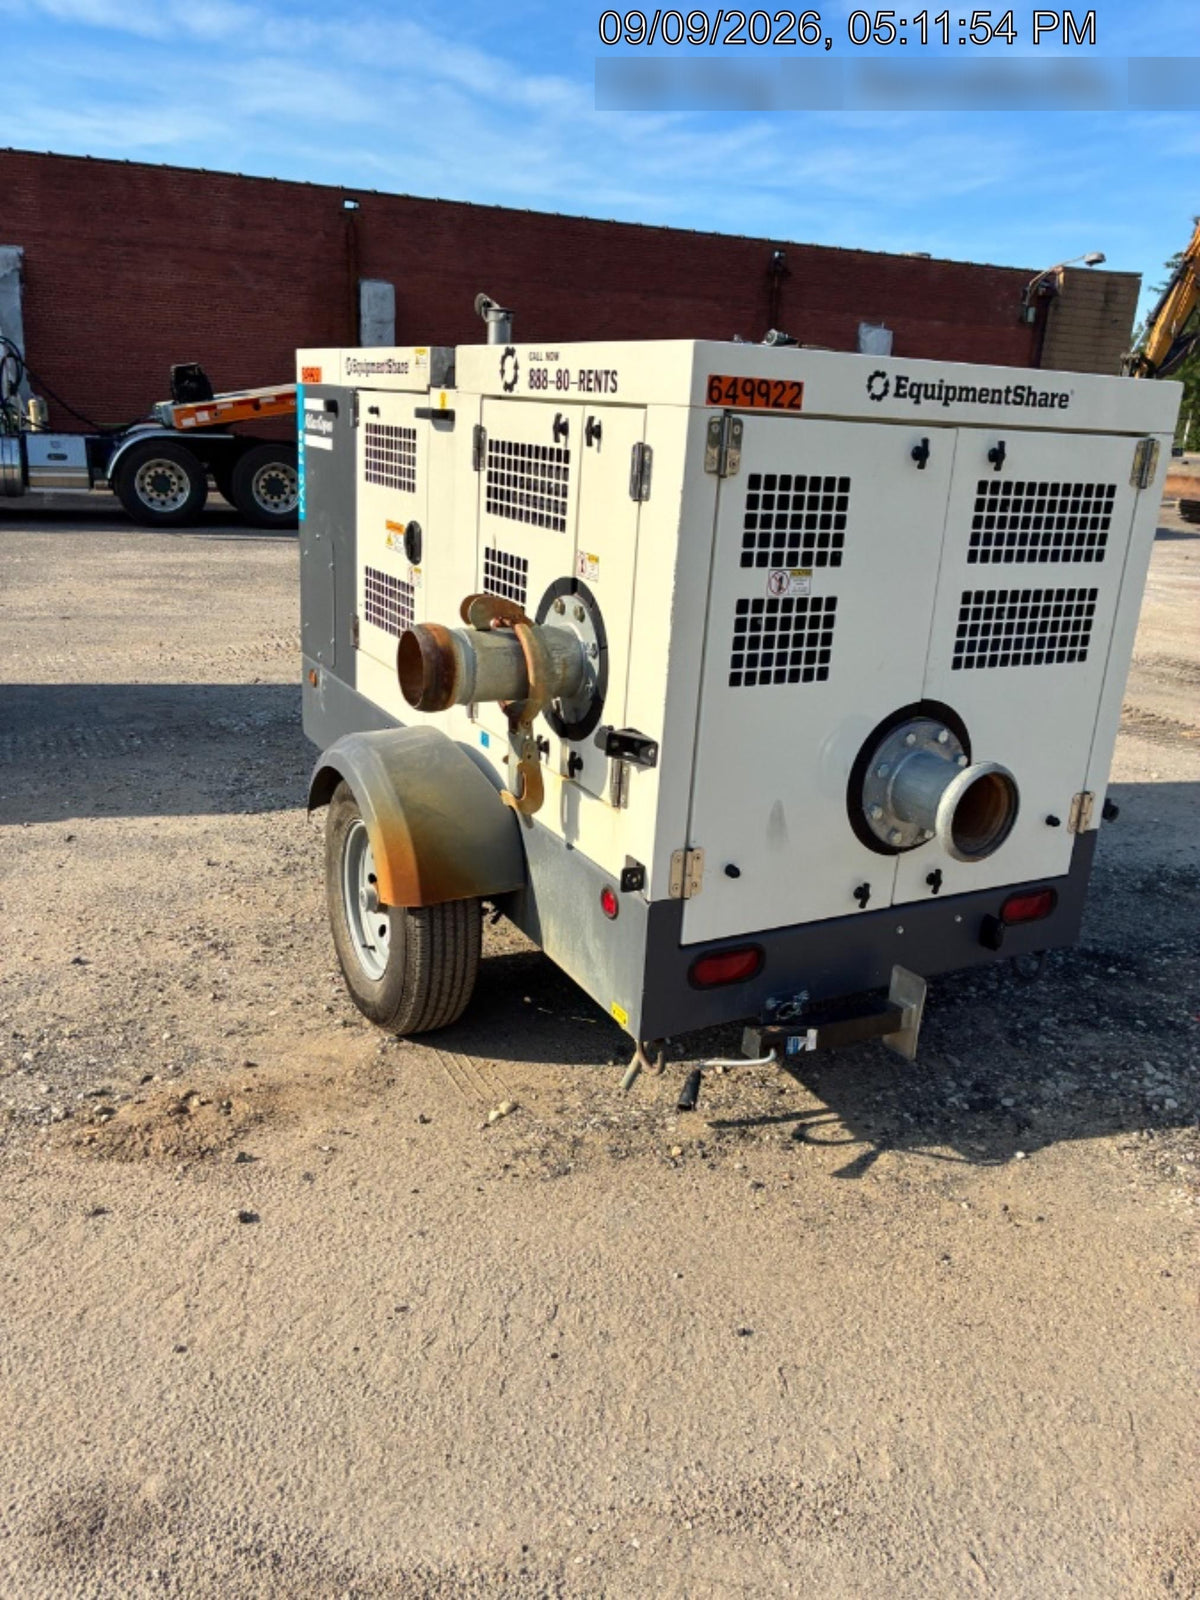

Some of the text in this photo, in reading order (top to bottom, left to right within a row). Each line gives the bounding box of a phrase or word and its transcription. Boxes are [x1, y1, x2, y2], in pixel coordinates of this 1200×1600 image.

[529, 352, 560, 362] CALL NOW
[528, 368, 619, 394] 888-80-RENTS
[708, 376, 803, 409] 649922
[894, 376, 1069, 409] EquipmentShare
